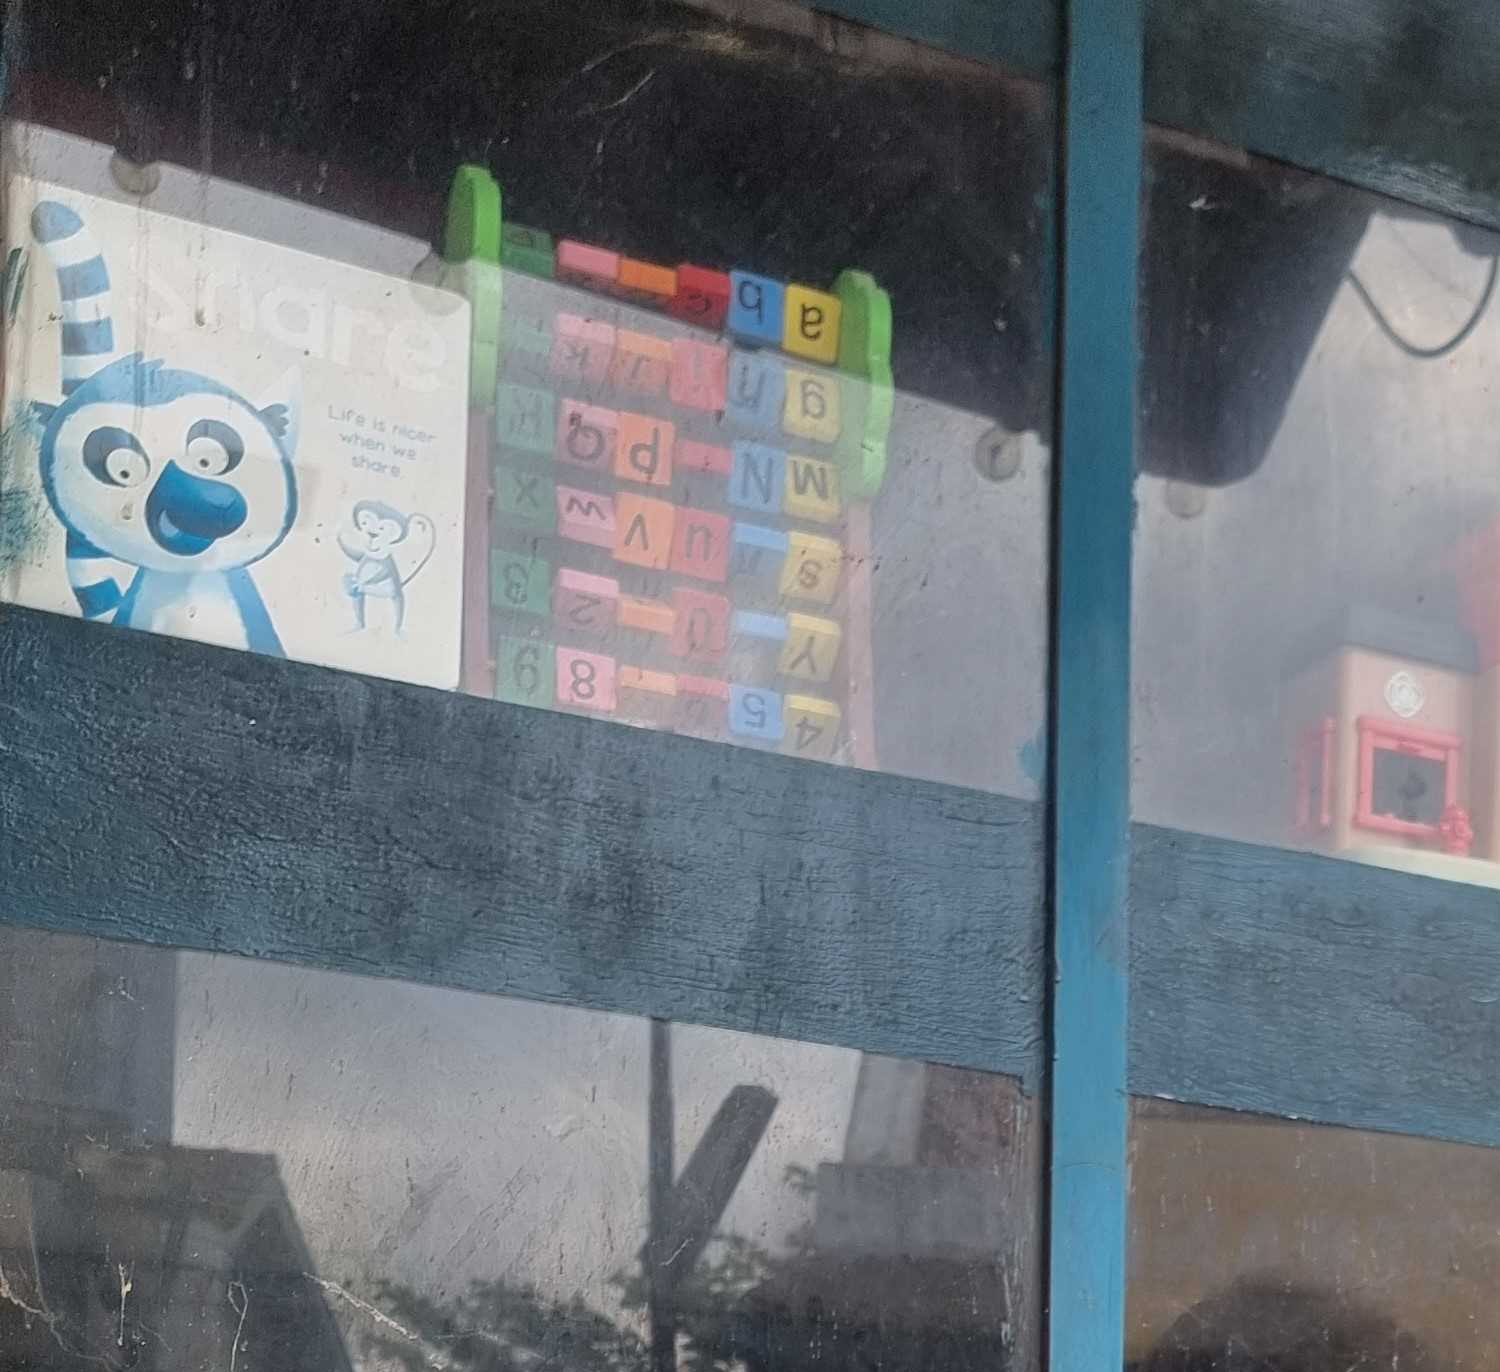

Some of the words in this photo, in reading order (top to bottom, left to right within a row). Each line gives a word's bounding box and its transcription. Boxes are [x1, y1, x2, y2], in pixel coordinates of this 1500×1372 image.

[738, 279, 763, 322] b
[799, 302, 824, 343] a
[327, 402, 366, 427] Life
[742, 458, 773, 505] N
[791, 459, 829, 501] M
[569, 659, 597, 701] 8
[743, 691, 768, 730] 5
